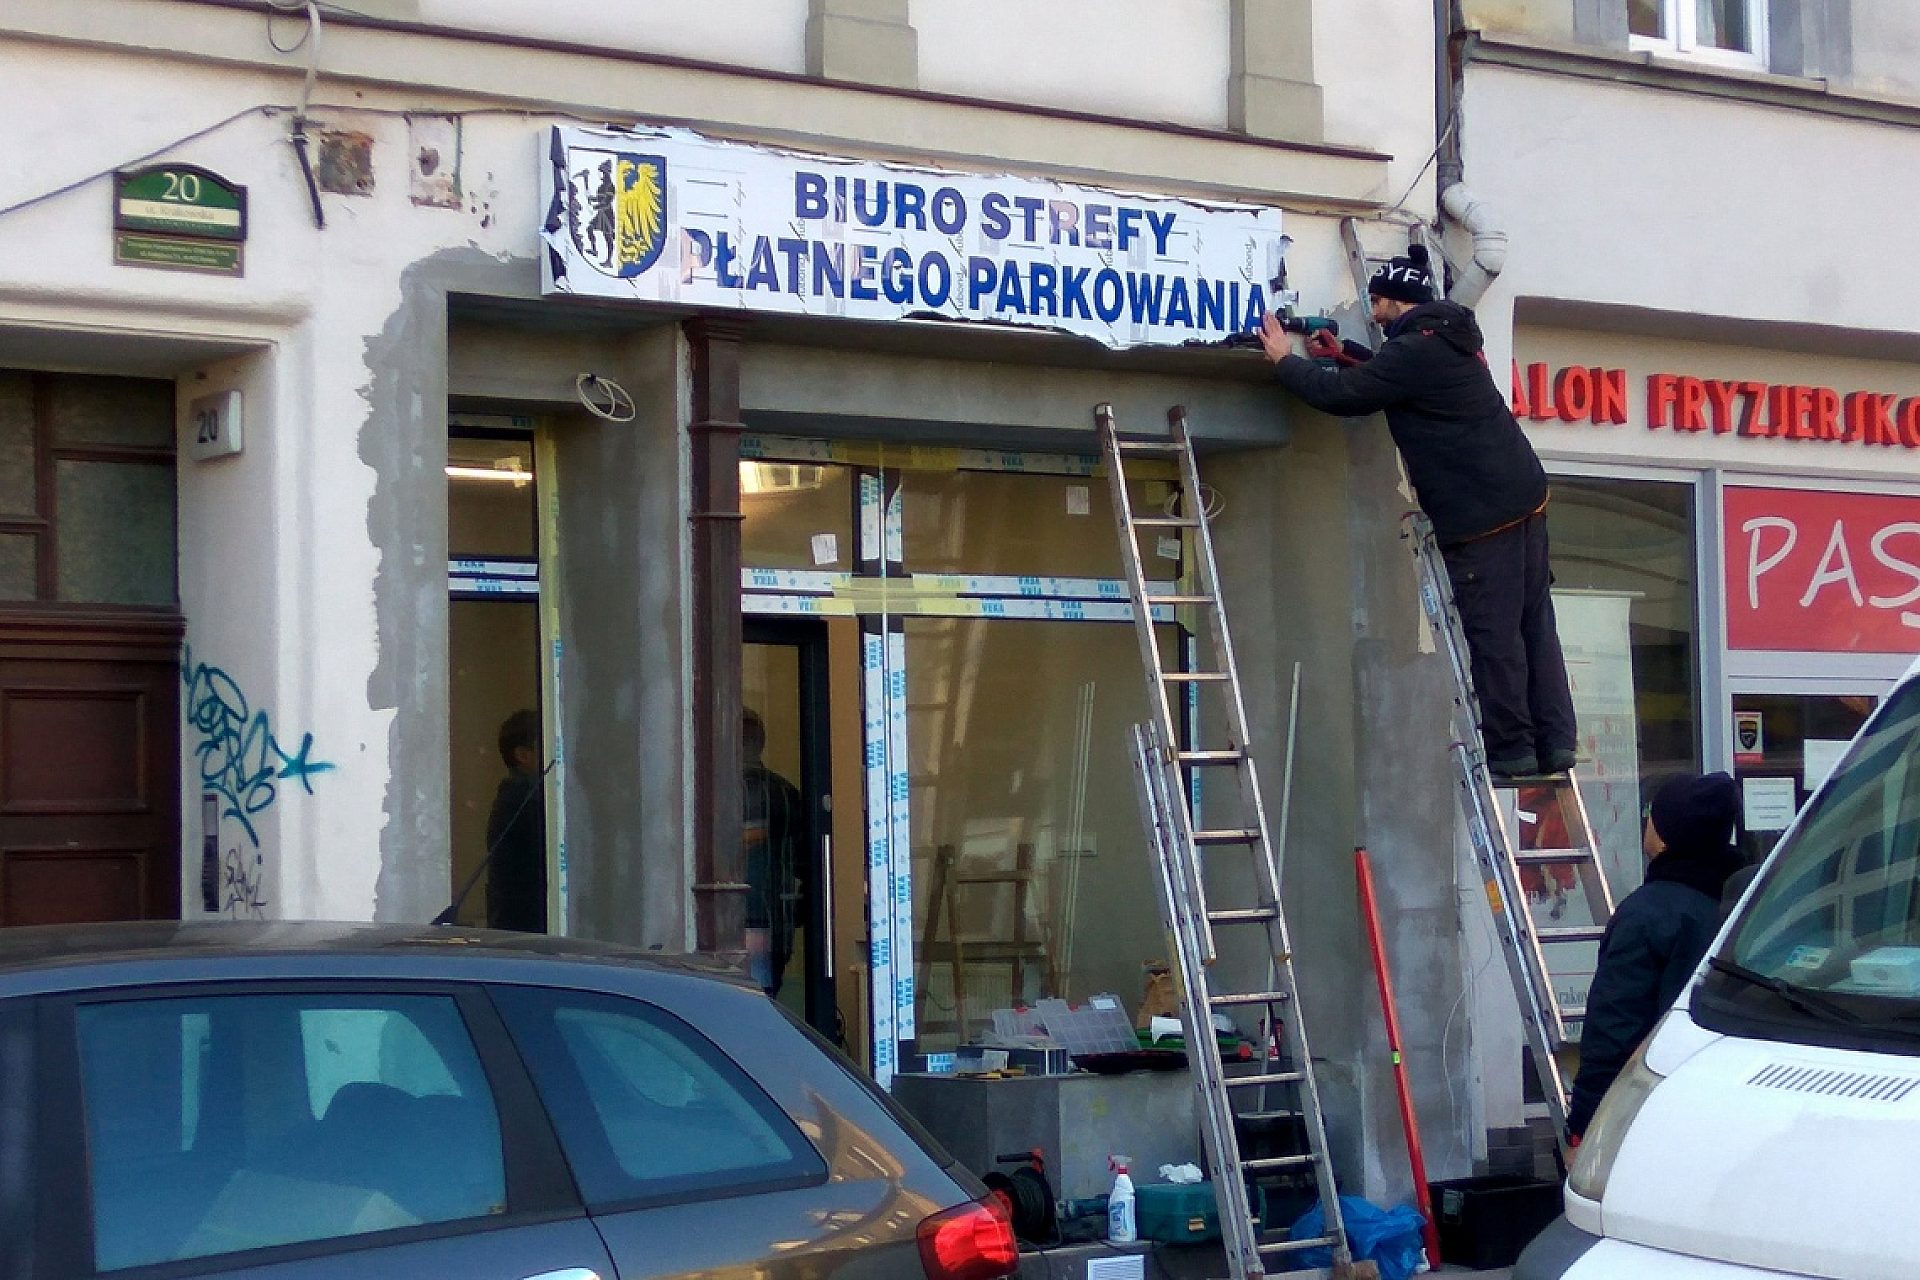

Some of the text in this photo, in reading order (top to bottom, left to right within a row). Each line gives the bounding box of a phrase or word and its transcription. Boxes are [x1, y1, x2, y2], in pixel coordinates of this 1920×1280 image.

[162, 172, 199, 201] 20
[795, 171, 967, 235] BIURO
[981, 192, 1177, 255] STREFY
[681, 228, 951, 307] PŁATNEGO
[968, 255, 1267, 333] PARKOWANIA
[194, 409, 218, 443] 20
